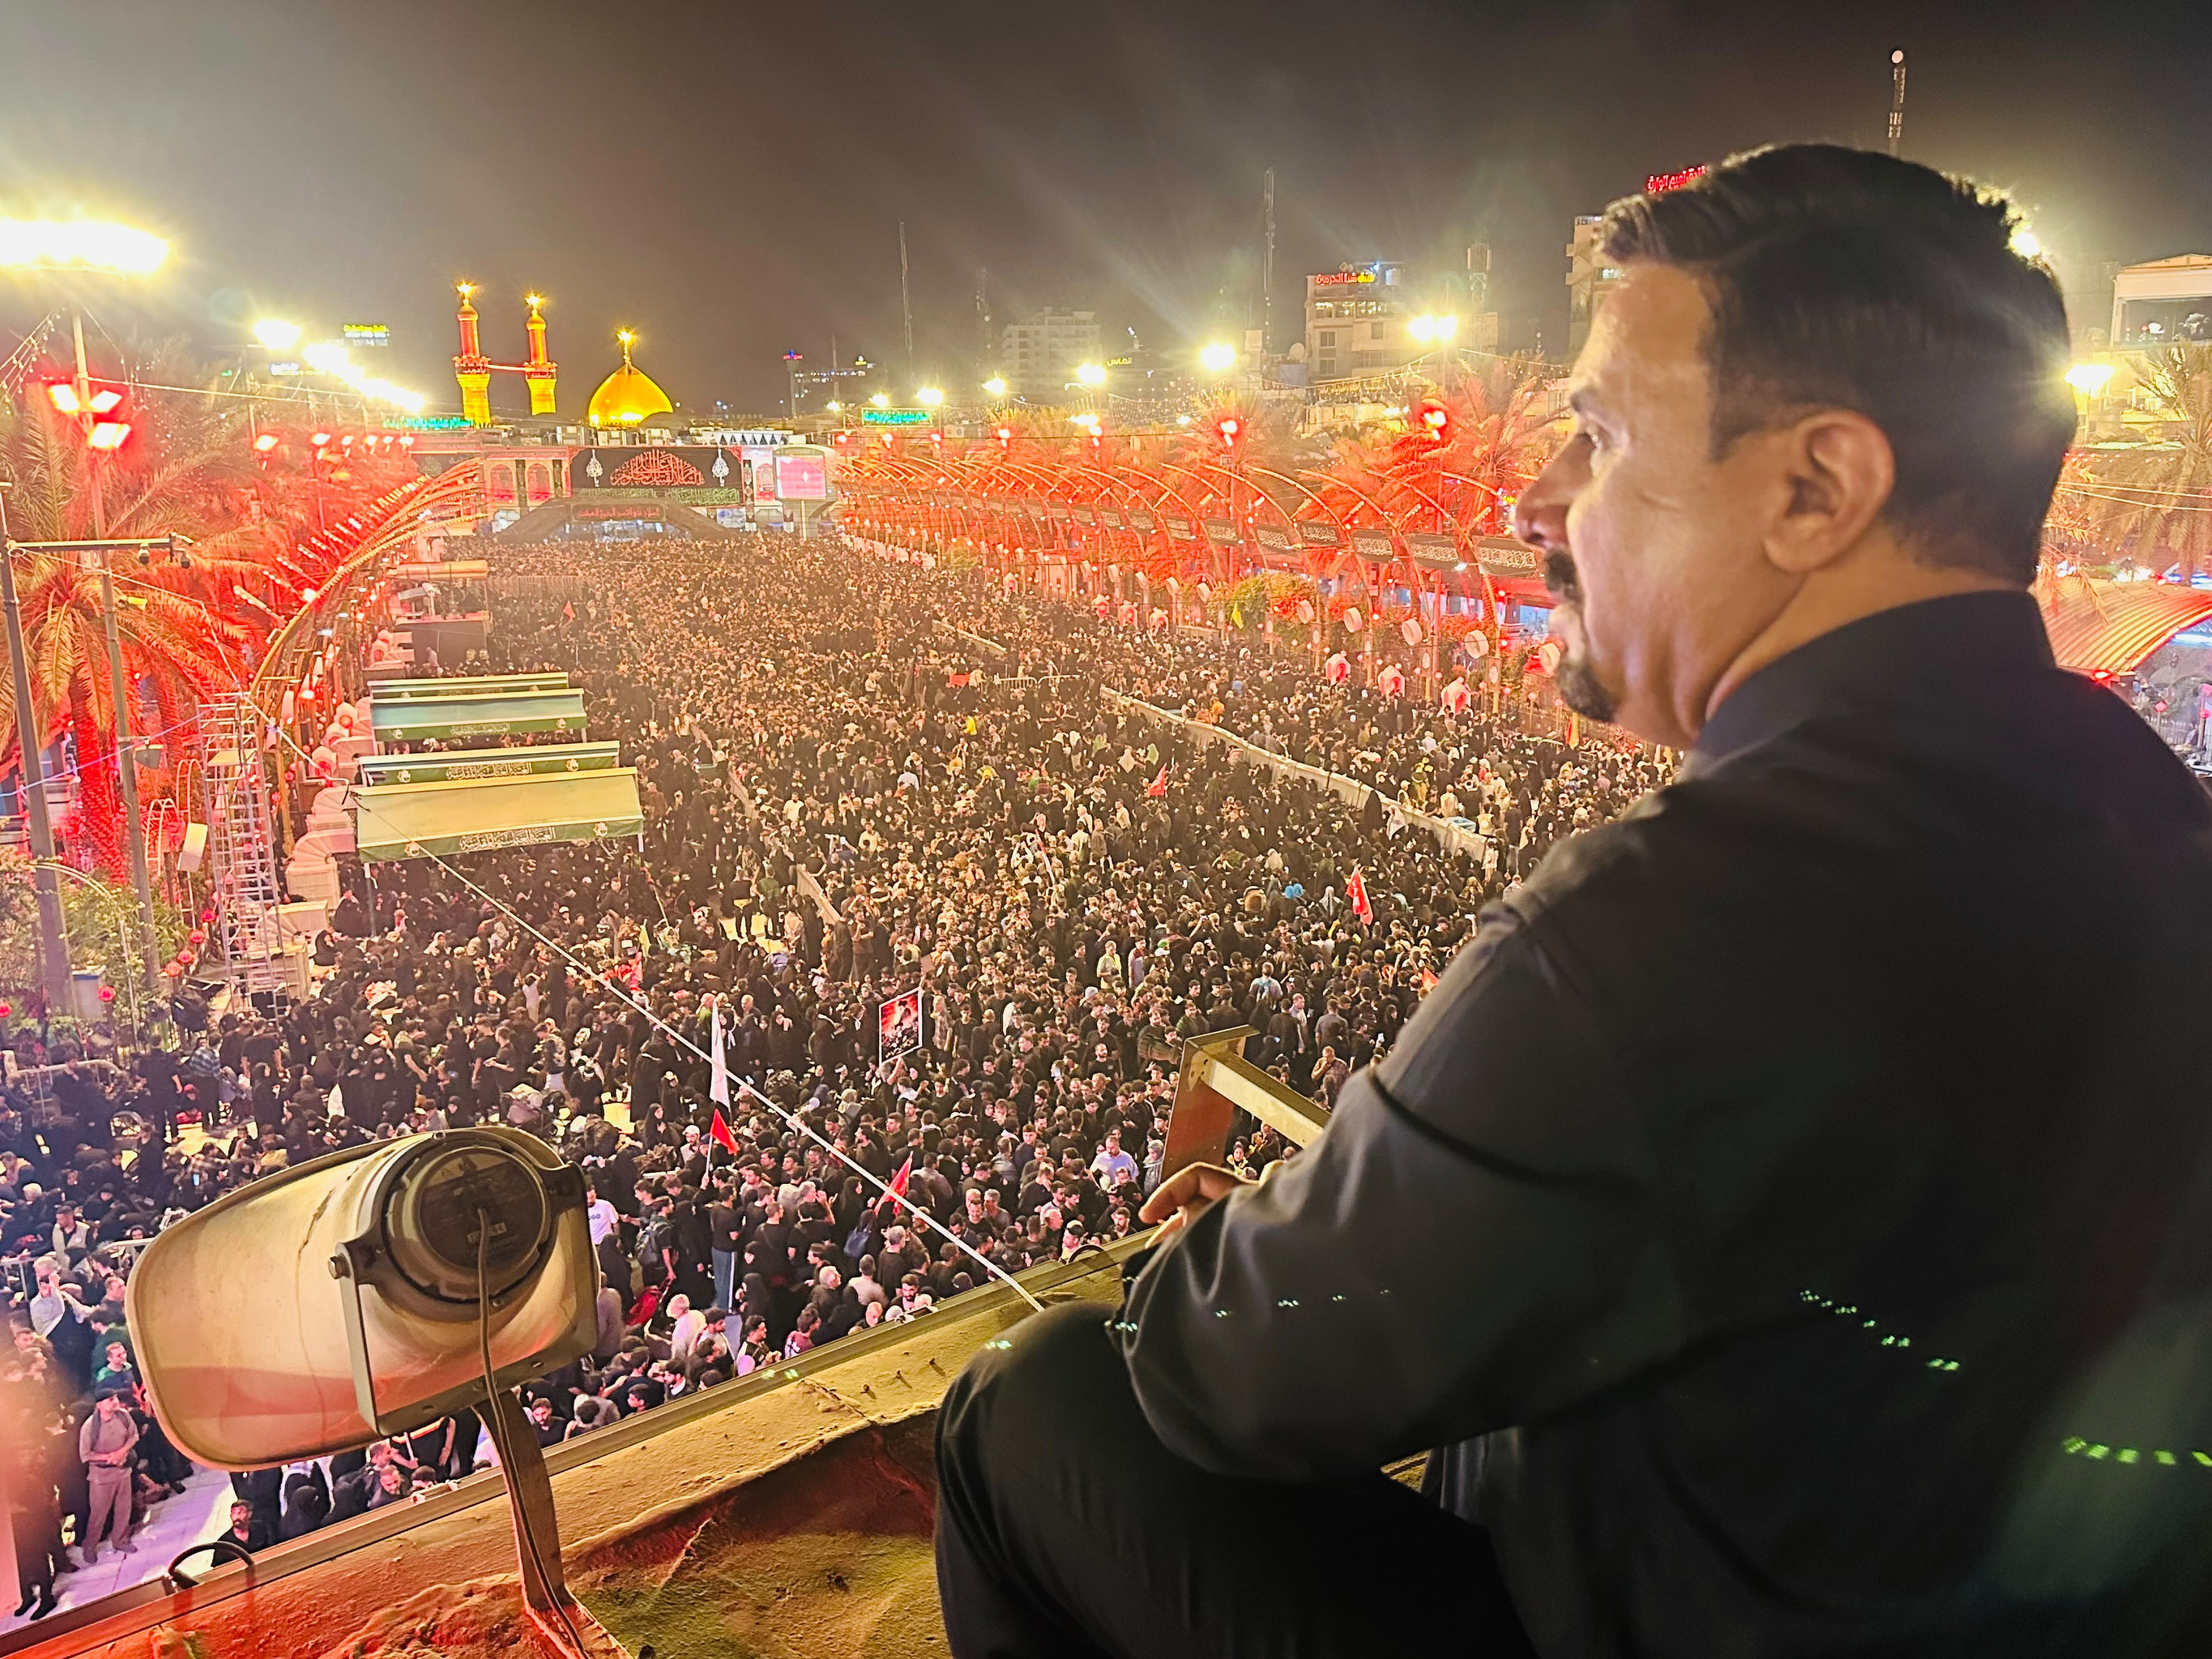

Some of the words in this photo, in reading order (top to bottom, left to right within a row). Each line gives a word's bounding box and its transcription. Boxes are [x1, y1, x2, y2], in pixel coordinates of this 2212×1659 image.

[1668, 171, 1687, 191] نعيم
[1686, 165, 1706, 183] فندق
[1647, 175, 1668, 193] الوارث
[1316, 273, 1344, 286] الحرمين
[1357, 272, 1375, 283] فندق
